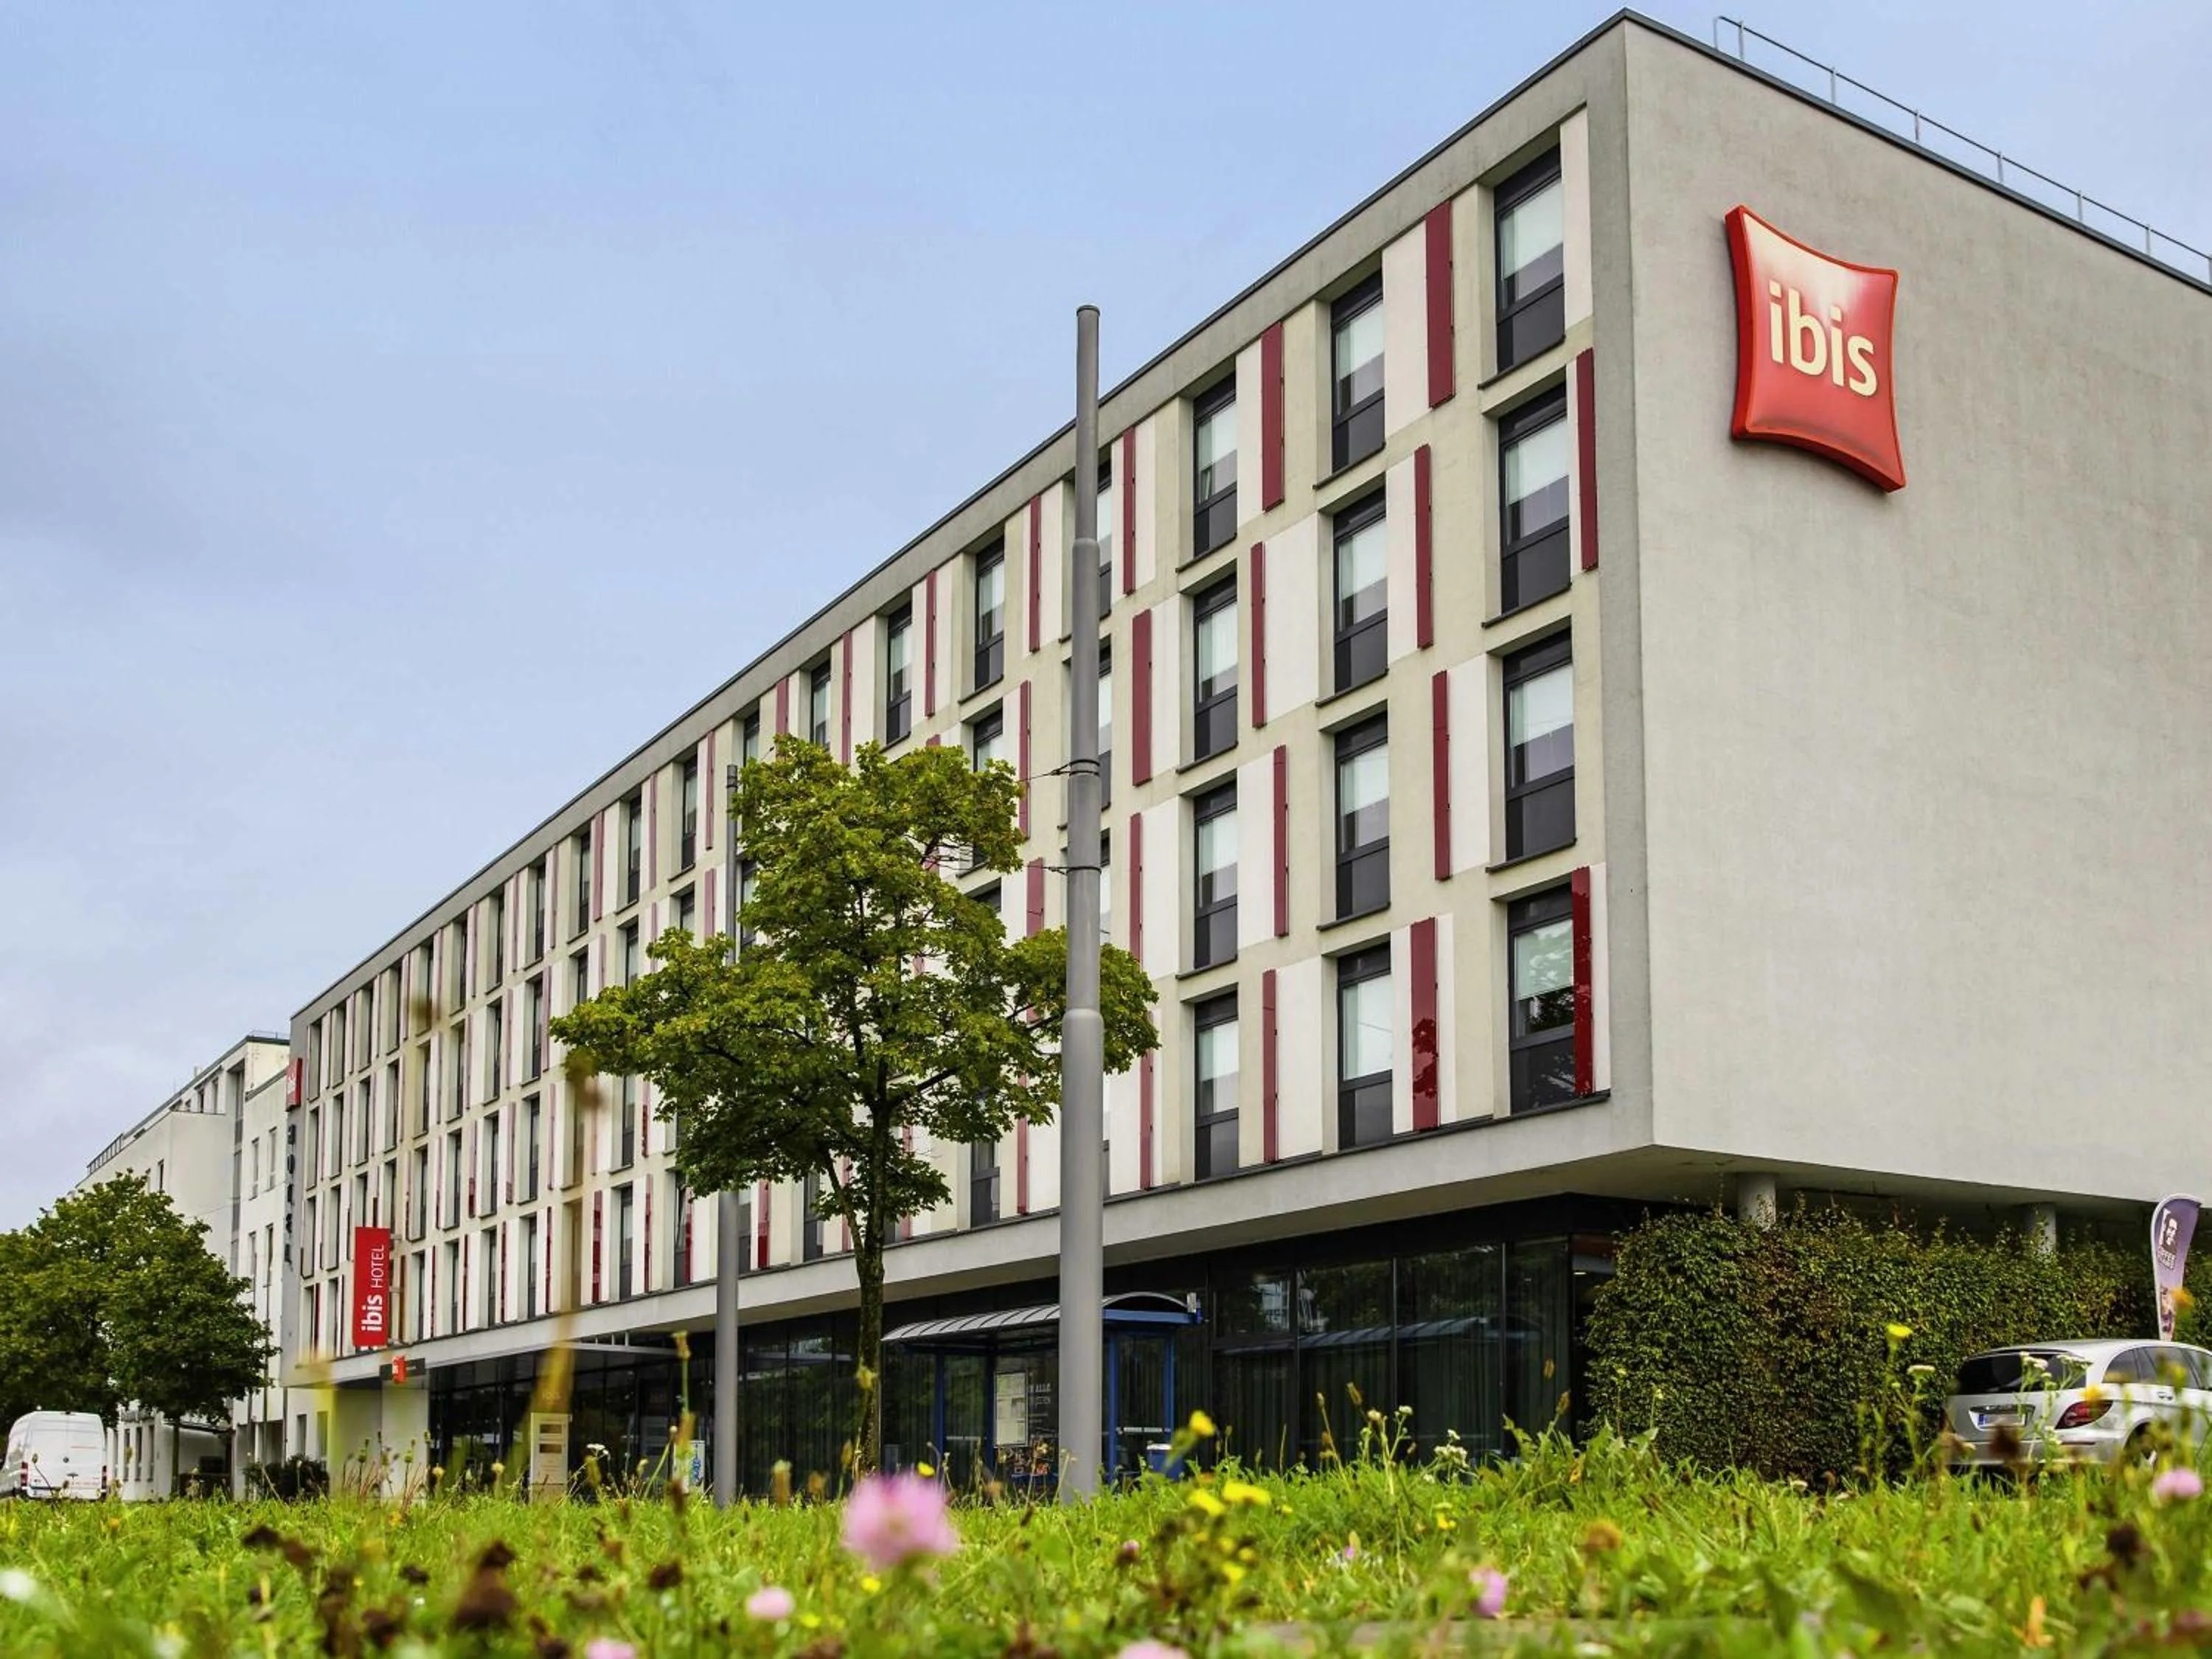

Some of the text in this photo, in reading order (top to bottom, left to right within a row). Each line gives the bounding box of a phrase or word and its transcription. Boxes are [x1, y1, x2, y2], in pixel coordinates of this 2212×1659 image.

[1769, 280, 1877, 397] ibis
[361, 1244, 385, 1332] ibis HOTEL
